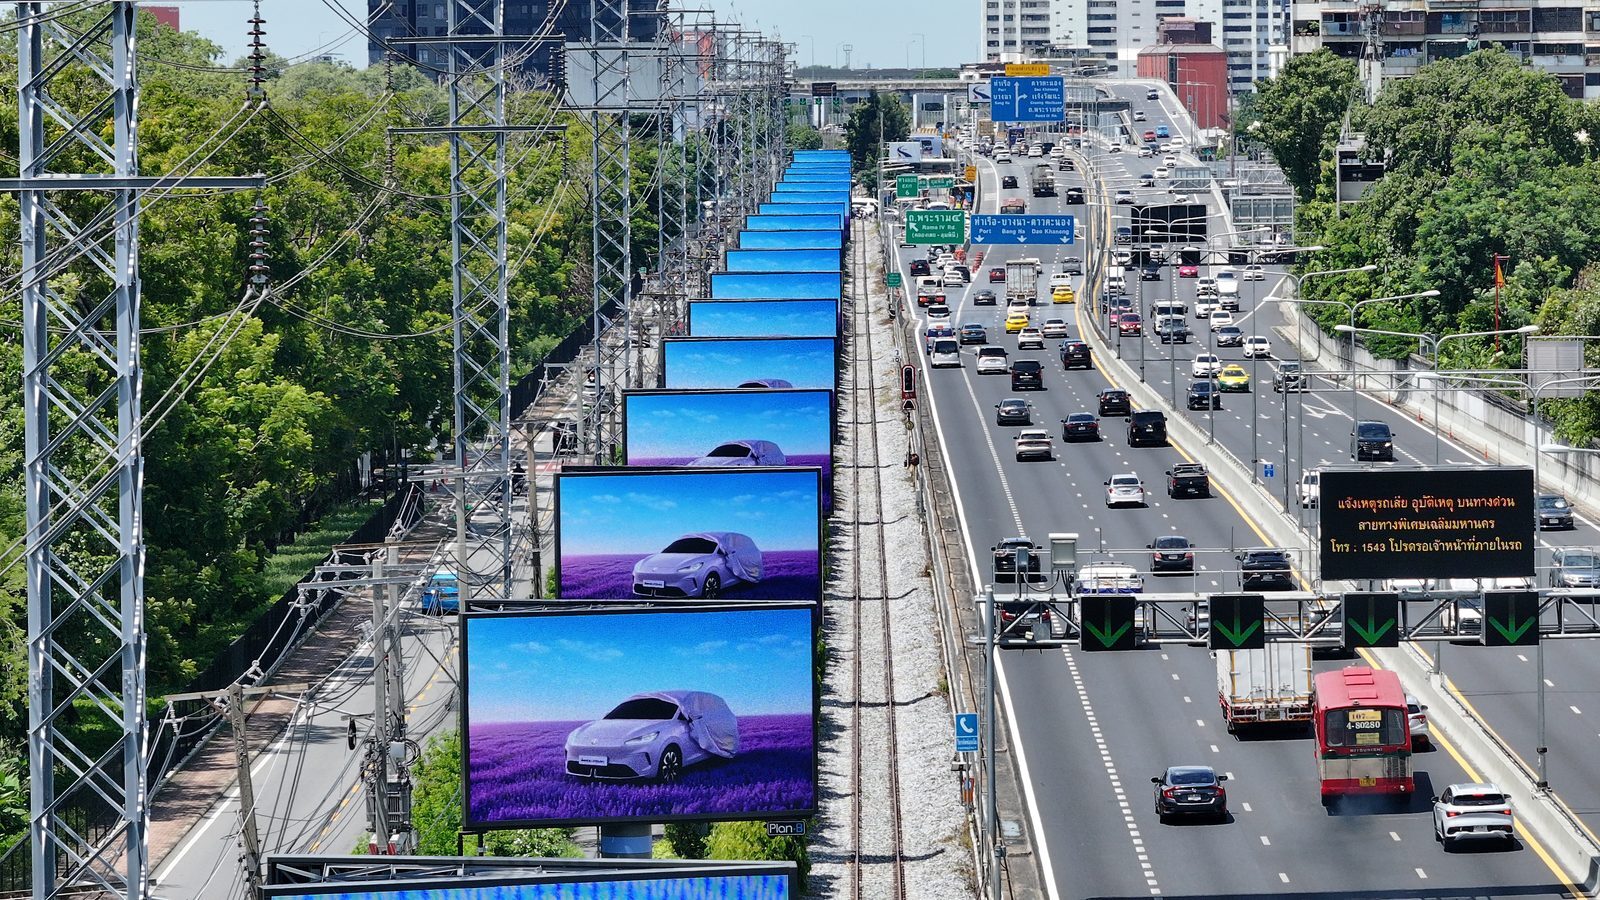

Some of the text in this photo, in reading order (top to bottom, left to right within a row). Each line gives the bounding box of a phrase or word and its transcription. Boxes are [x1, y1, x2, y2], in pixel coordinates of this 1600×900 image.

[909, 212, 962, 222] ถ.พระราม๔
[1338, 495, 1515, 513] แจ้งเหตุรถเสีย อุบัติเหตุ บนทางด่วน
[1358, 517, 1495, 531] สายทางพิเศษเฉลิมมหานคร
[1330, 538, 1350, 552] โทร
[1362, 543, 1386, 552] 1543
[1389, 535, 1522, 552] โปรดรอเจ้าหน้าที่ภายในรถ
